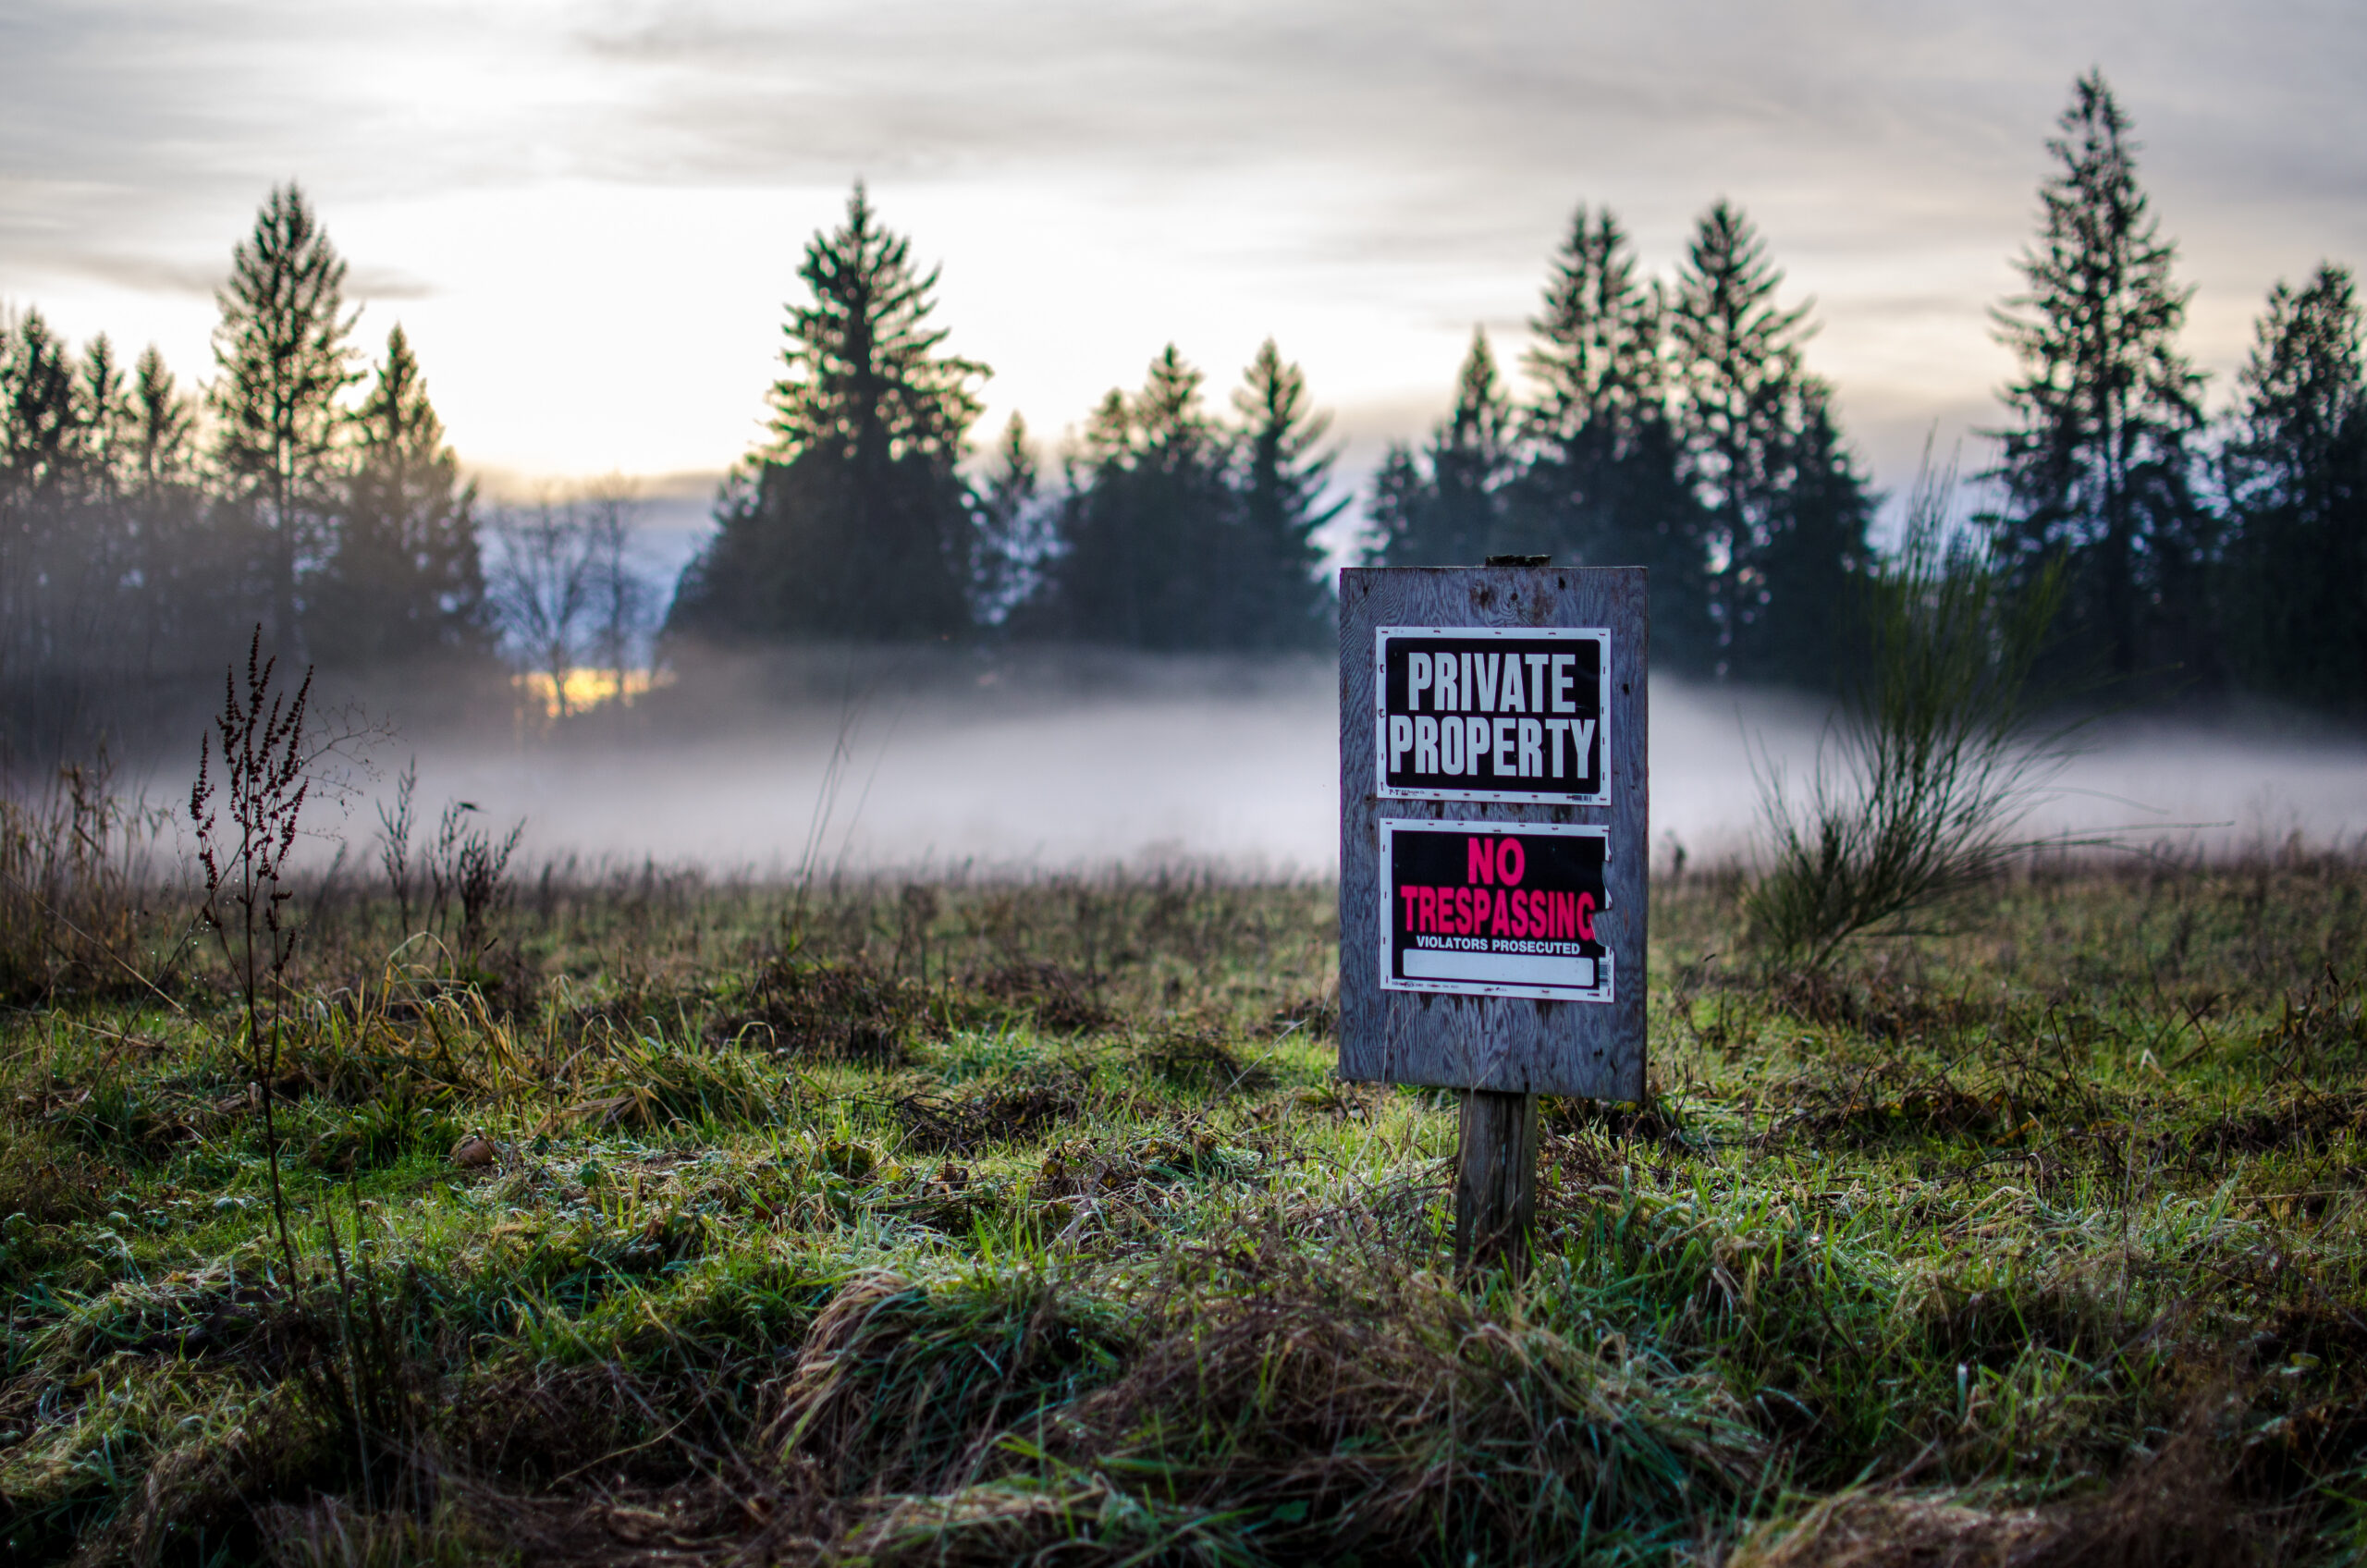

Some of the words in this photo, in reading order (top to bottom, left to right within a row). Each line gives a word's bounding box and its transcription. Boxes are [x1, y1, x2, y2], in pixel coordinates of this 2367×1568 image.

[1408, 652, 1576, 713] PRIVATE
[1390, 715, 1596, 778] PROPERTY
[1467, 837, 1526, 887] NO
[1400, 885, 1596, 940] TRESPASSING
[1416, 935, 1489, 951] VIOLATORS
[1492, 938, 1580, 955] PROSECUTED
